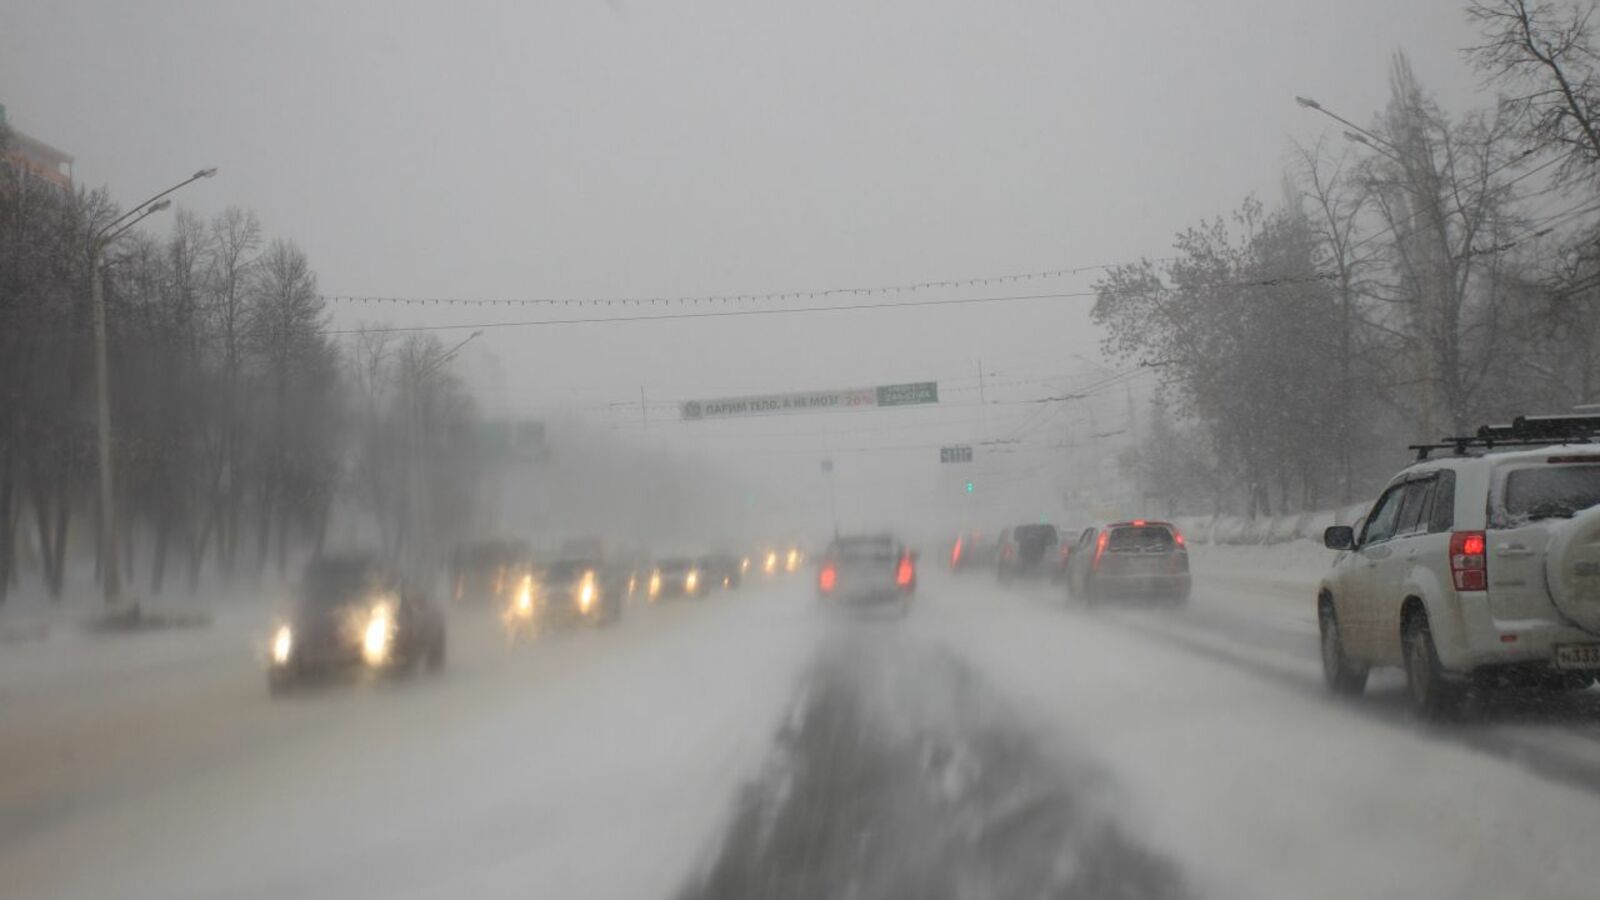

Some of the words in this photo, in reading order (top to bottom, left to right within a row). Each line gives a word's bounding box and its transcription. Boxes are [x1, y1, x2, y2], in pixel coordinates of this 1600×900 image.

[706, 402, 747, 415] ПАРИМ
[783, 398, 791, 408] А
[794, 397, 807, 408] НЕ
